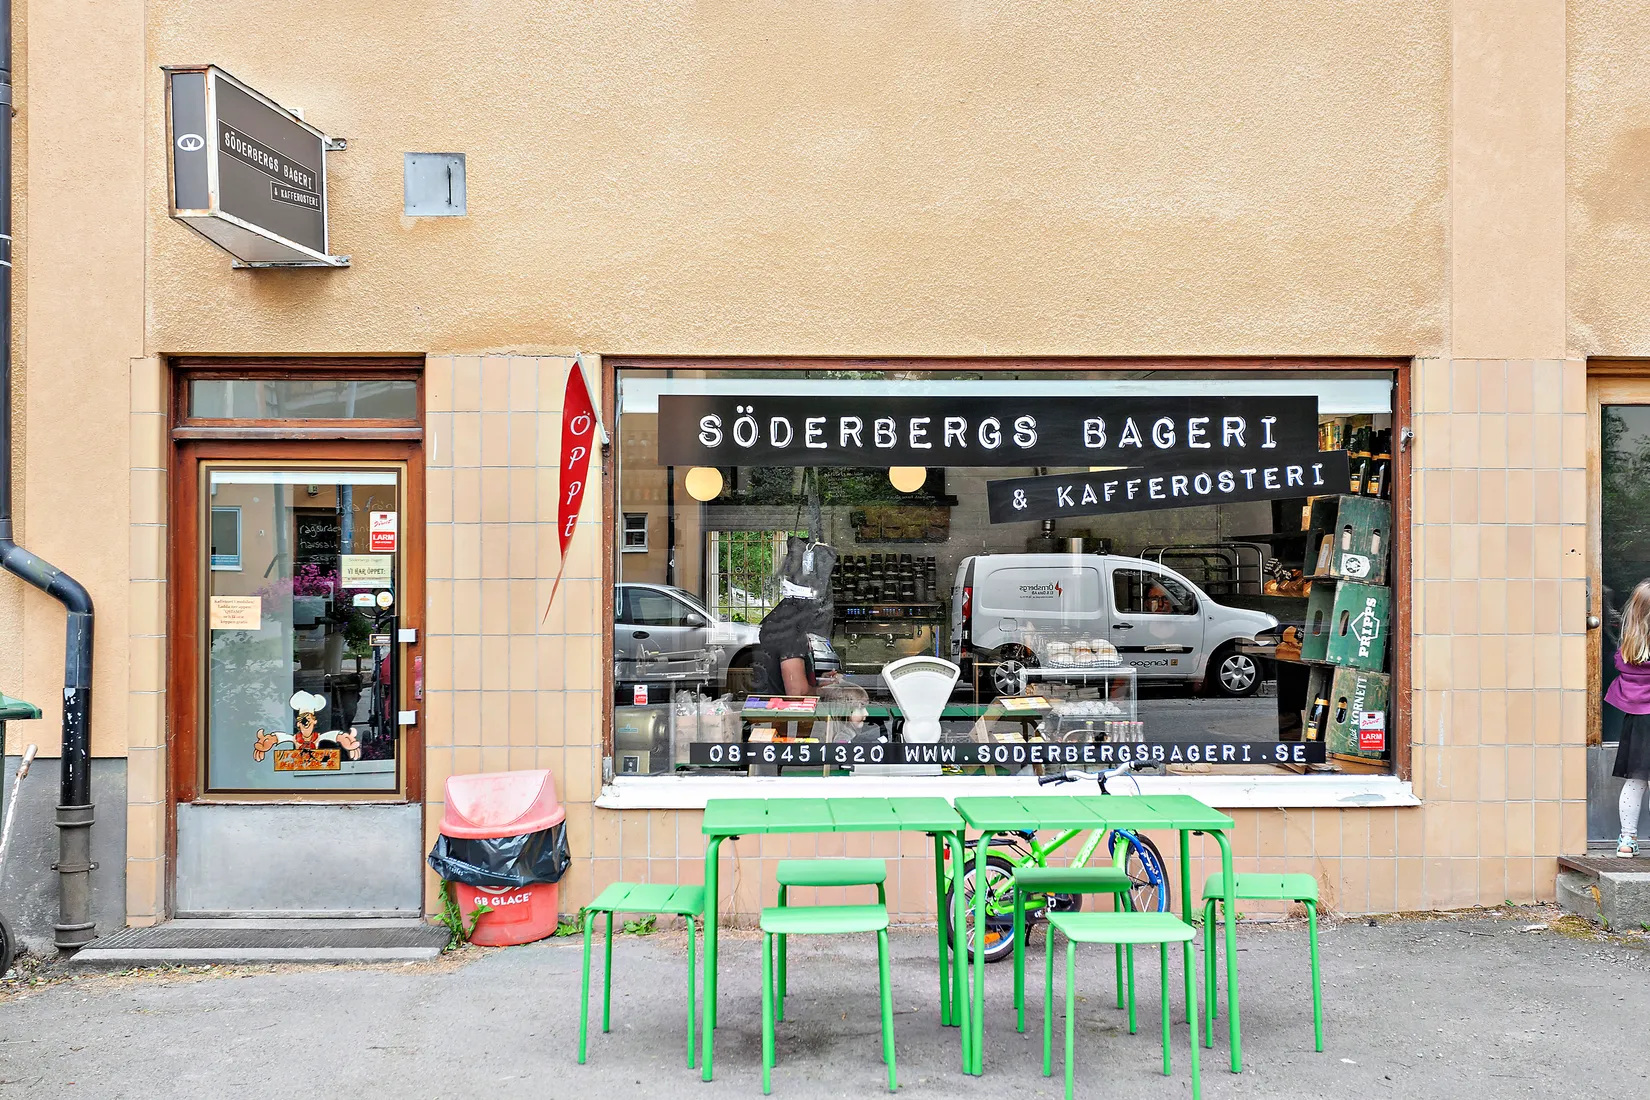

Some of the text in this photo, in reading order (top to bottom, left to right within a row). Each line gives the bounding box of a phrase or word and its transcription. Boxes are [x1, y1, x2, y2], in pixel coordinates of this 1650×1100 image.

[224, 131, 312, 190] SÖDERBERGS BAGERI
[280, 189, 319, 207] KAFFEROSTERI
[698, 405, 1278, 450] SÖDERBERGS BAGERI
[1012, 462, 1326, 511] & KAFFEROSTERI
[372, 533, 395, 541] LARM
[1358, 597, 1377, 658] PRIPPS
[709, 743, 1308, 763] 08-6451320 WWW.SODERBERGSBAGERI.SE
[474, 893, 530, 906] GB GLACE
